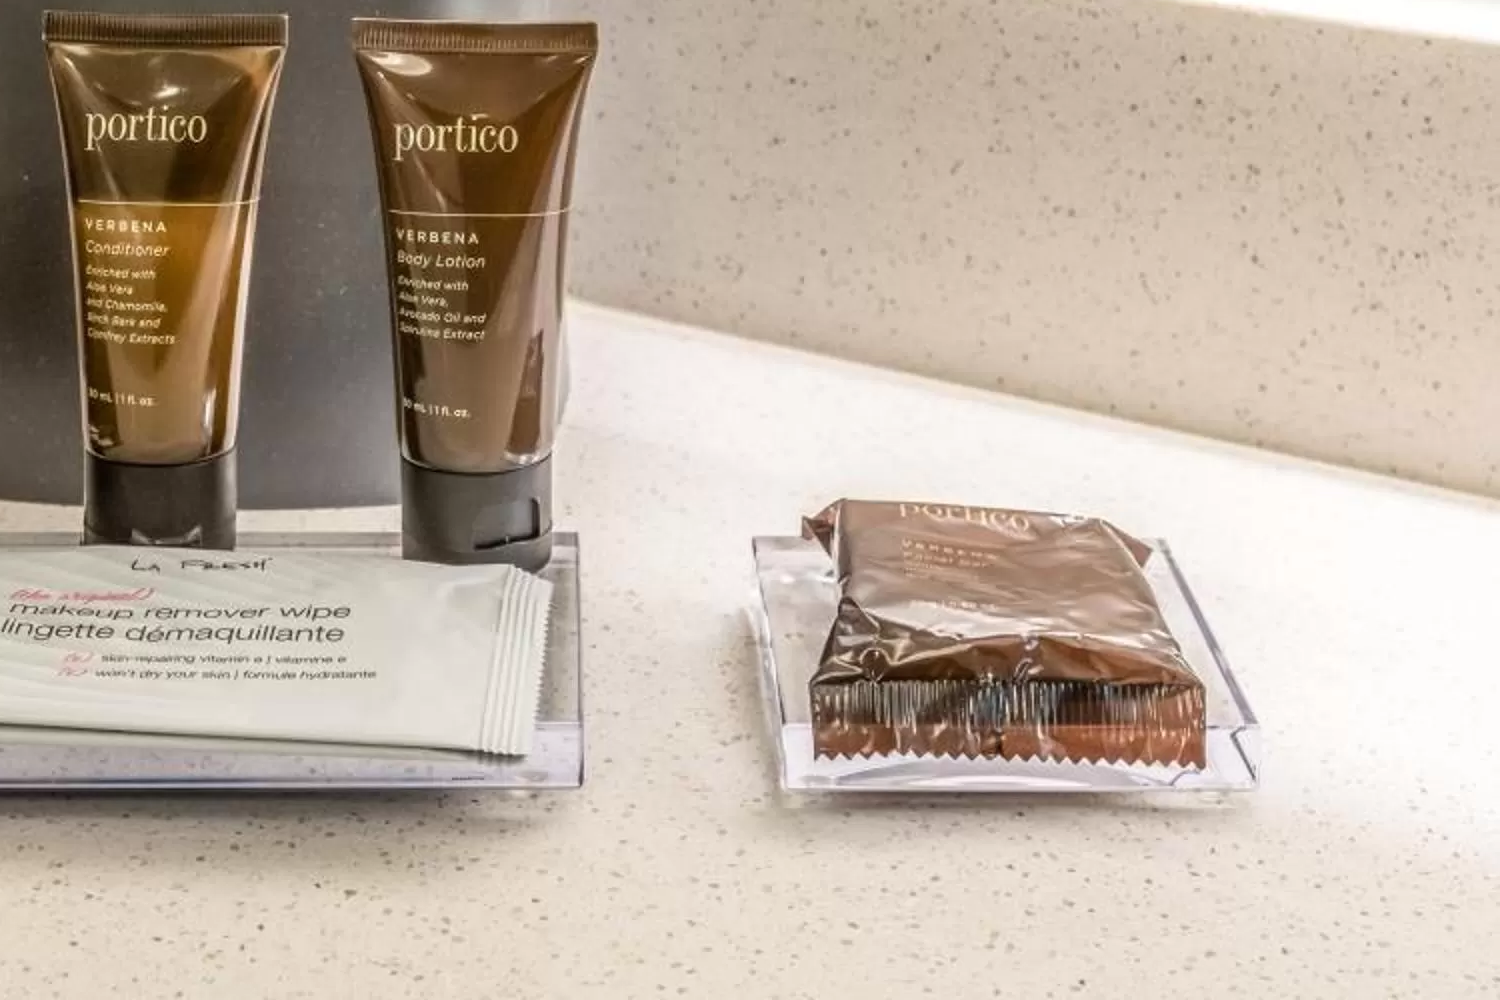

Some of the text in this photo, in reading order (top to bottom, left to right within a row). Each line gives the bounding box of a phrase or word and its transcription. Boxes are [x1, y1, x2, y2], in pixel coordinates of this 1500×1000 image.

[84, 104, 207, 151] portico
[392, 115, 519, 161] portico
[85, 217, 168, 233] VERBENA
[396, 228, 479, 245] VERBENA
[85, 239, 171, 257] Conditioner
[397, 249, 486, 269] Body Lotion
[131, 268, 156, 280] with
[109, 283, 133, 295] Vera
[443, 281, 469, 291] with
[139, 317, 161, 329] and
[443, 311, 461, 324] Oil
[463, 313, 487, 324] and
[129, 332, 176, 345] Extracts
[443, 329, 486, 341] Extract
[9, 602, 352, 621] makeup remover wipe
[0, 617, 345, 644] lingette démaquillante
[199, 655, 249, 664] vitamin
[95, 667, 136, 678] won't
[139, 667, 164, 679] dry
[166, 670, 198, 680] your
[299, 669, 377, 680] hydratante
